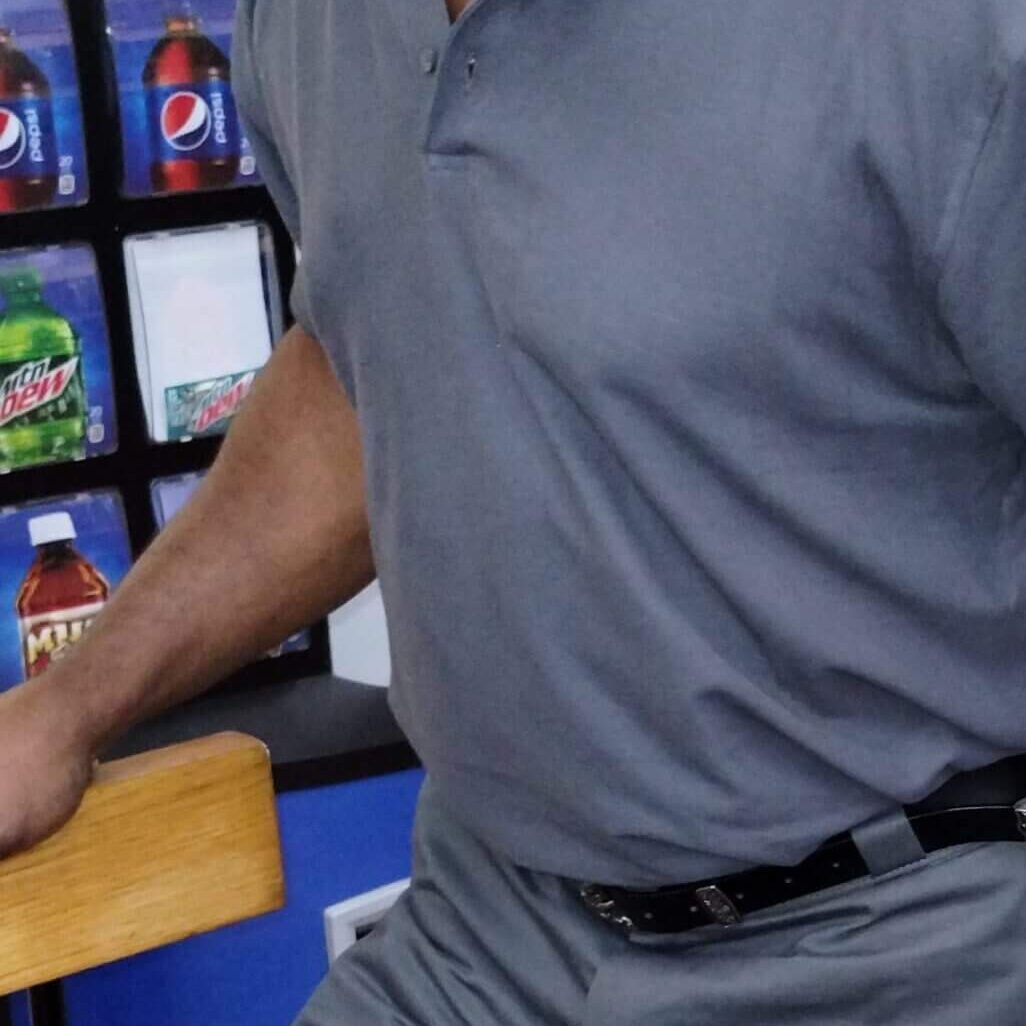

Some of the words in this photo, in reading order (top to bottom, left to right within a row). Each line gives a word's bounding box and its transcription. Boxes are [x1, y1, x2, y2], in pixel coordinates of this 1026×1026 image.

[24, 108, 44, 162] pepsi
[210, 92, 227, 143] pepsi
[27, 618, 93, 666] MU
